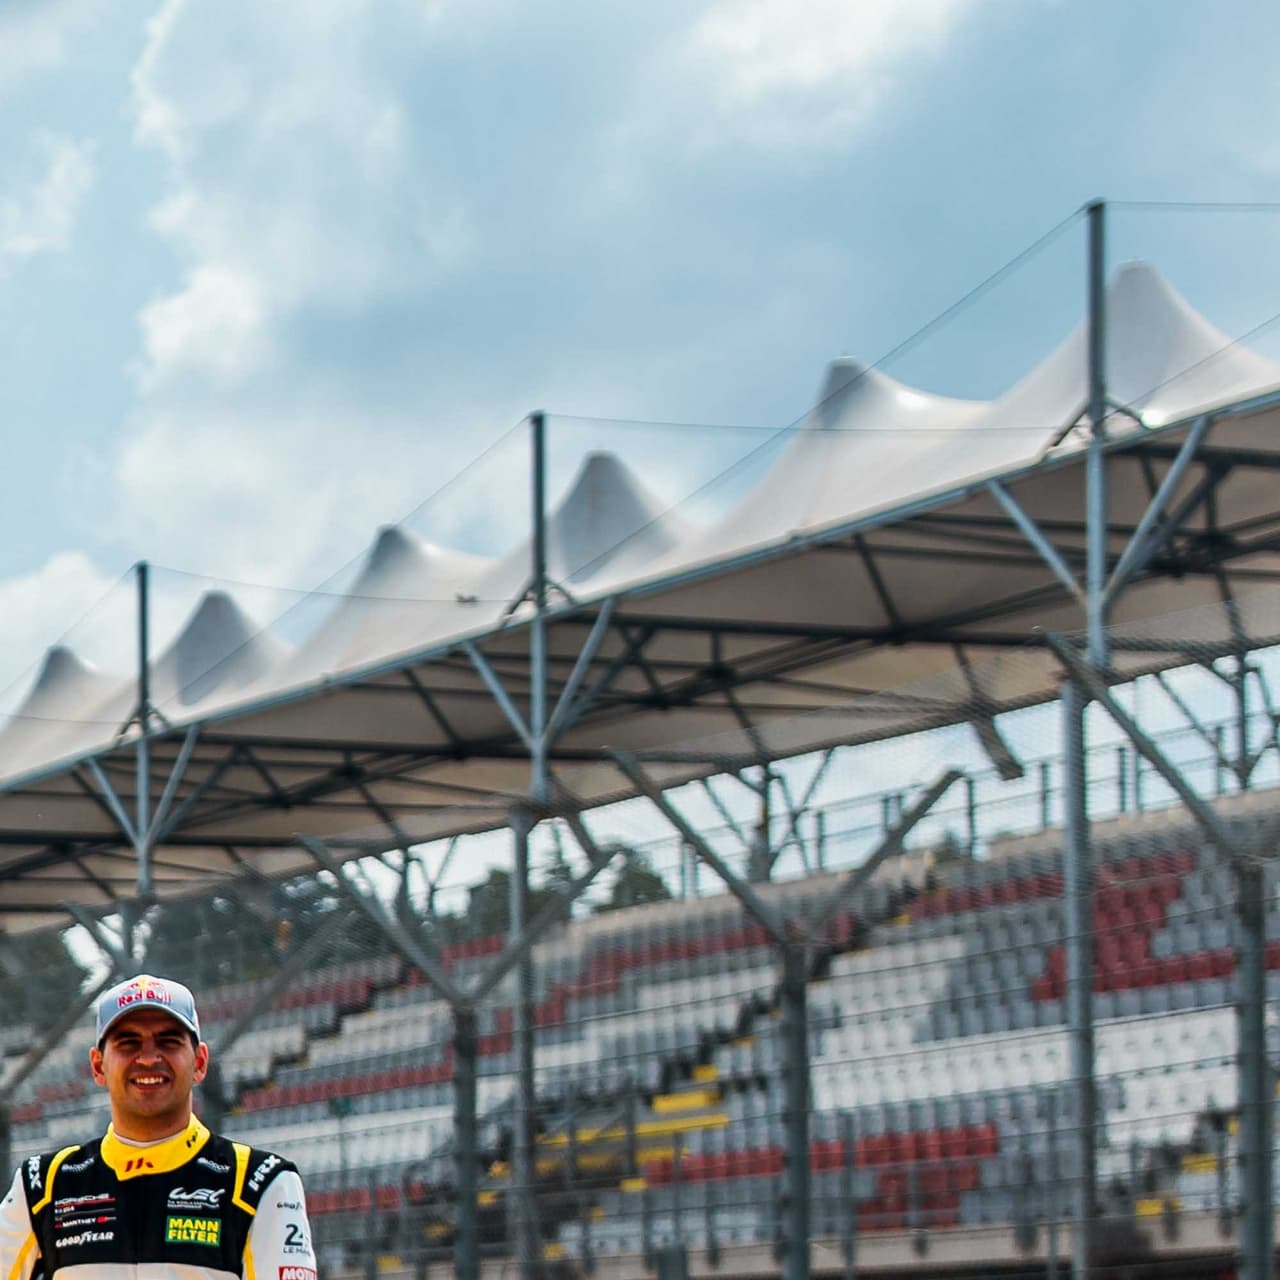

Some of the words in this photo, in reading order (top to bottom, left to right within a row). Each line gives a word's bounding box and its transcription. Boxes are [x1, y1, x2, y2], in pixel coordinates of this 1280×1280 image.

[247, 1154, 281, 1192] HRX
[168, 1186, 226, 1203] WEC
[169, 1218, 219, 1233] MANN
[55, 1230, 114, 1248] GOODYEAR
[167, 1229, 218, 1244] FILTER
